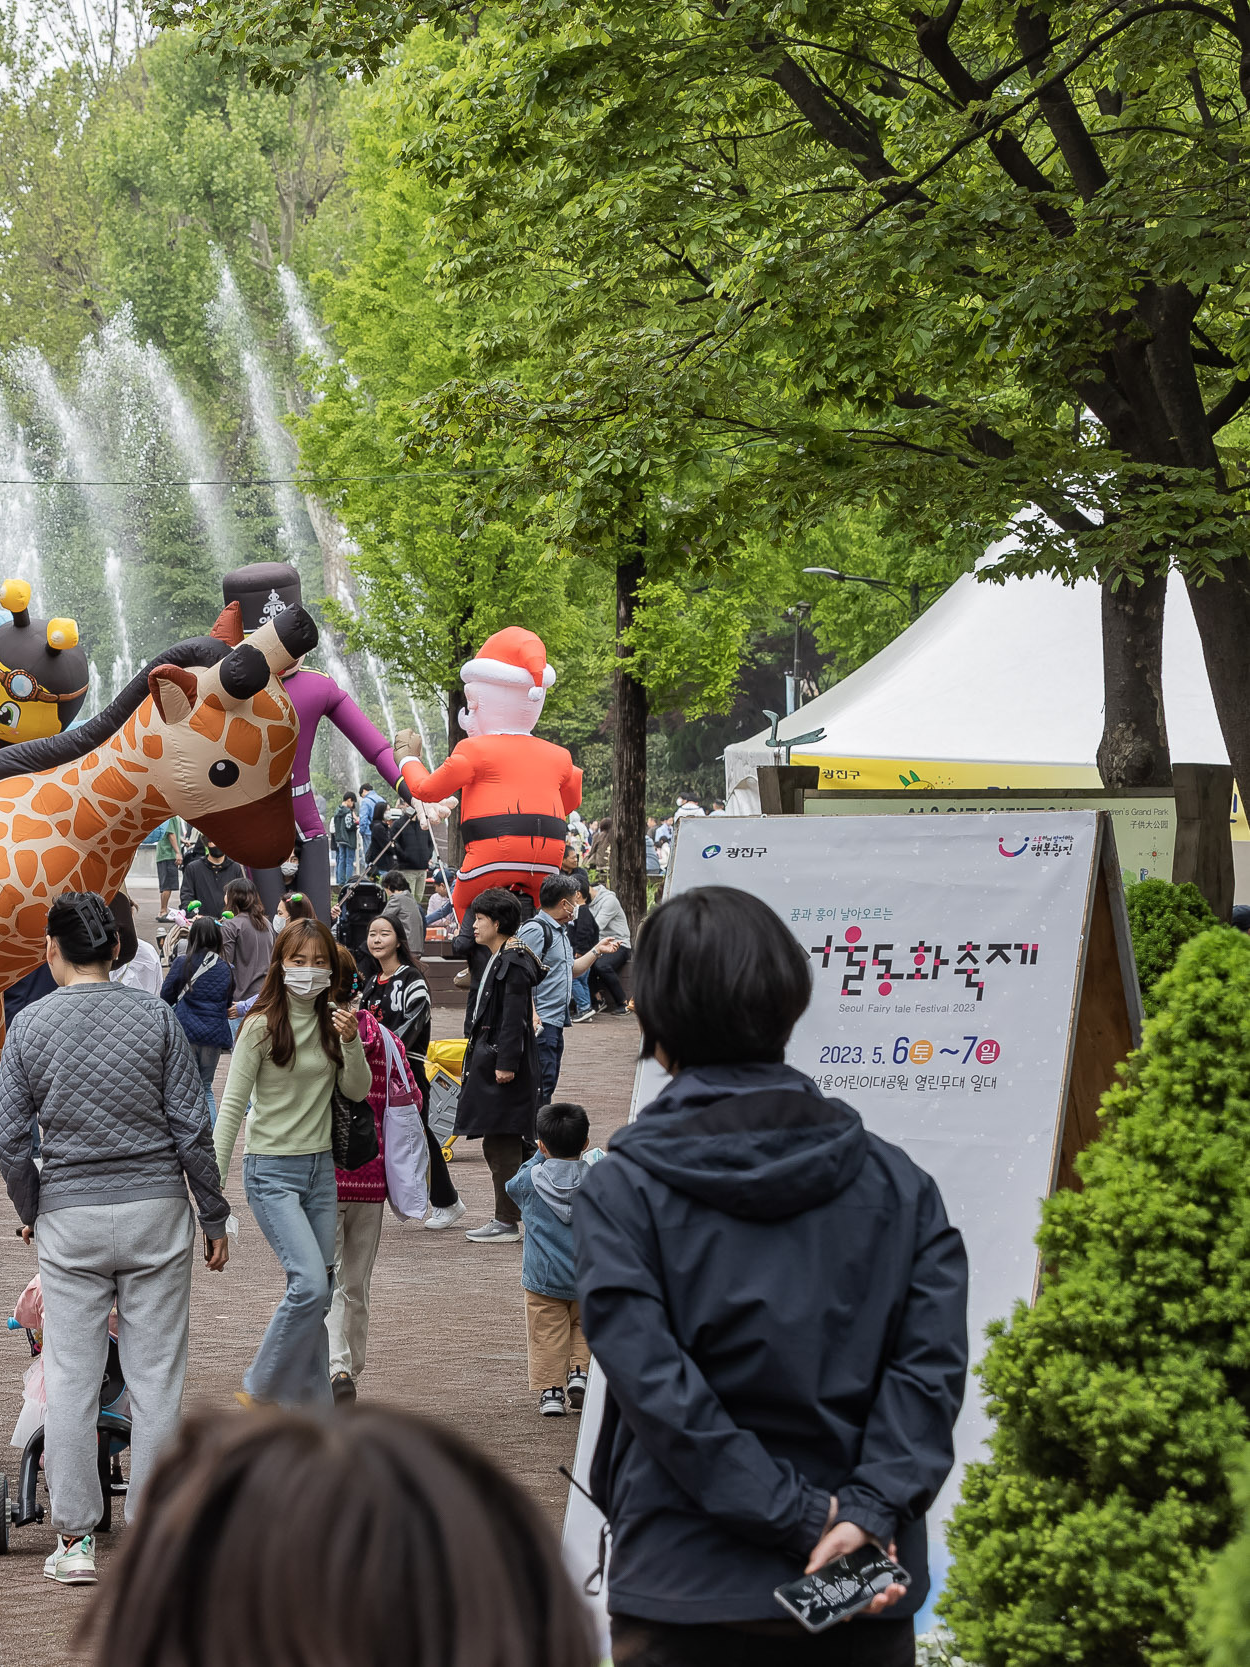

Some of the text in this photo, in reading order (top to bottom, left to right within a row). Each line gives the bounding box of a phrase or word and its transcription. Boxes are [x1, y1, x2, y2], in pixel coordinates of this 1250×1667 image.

[822, 768, 861, 780] 광진구
[1131, 808, 1152, 816] Grand
[1153, 808, 1169, 816] Park
[725, 847, 768, 858] 광진구
[1030, 842, 1073, 858] 행복광진
[790, 907, 893, 921] 꿈과 흥이 날아오르는
[839, 1003, 976, 1015] Seoul Fairy tale Festival 2023
[819, 1046, 866, 1064] 2023.
[872, 1046, 886, 1064] 5.
[915, 1074, 965, 1091] 열린무대
[971, 1074, 997, 1092] 일대
